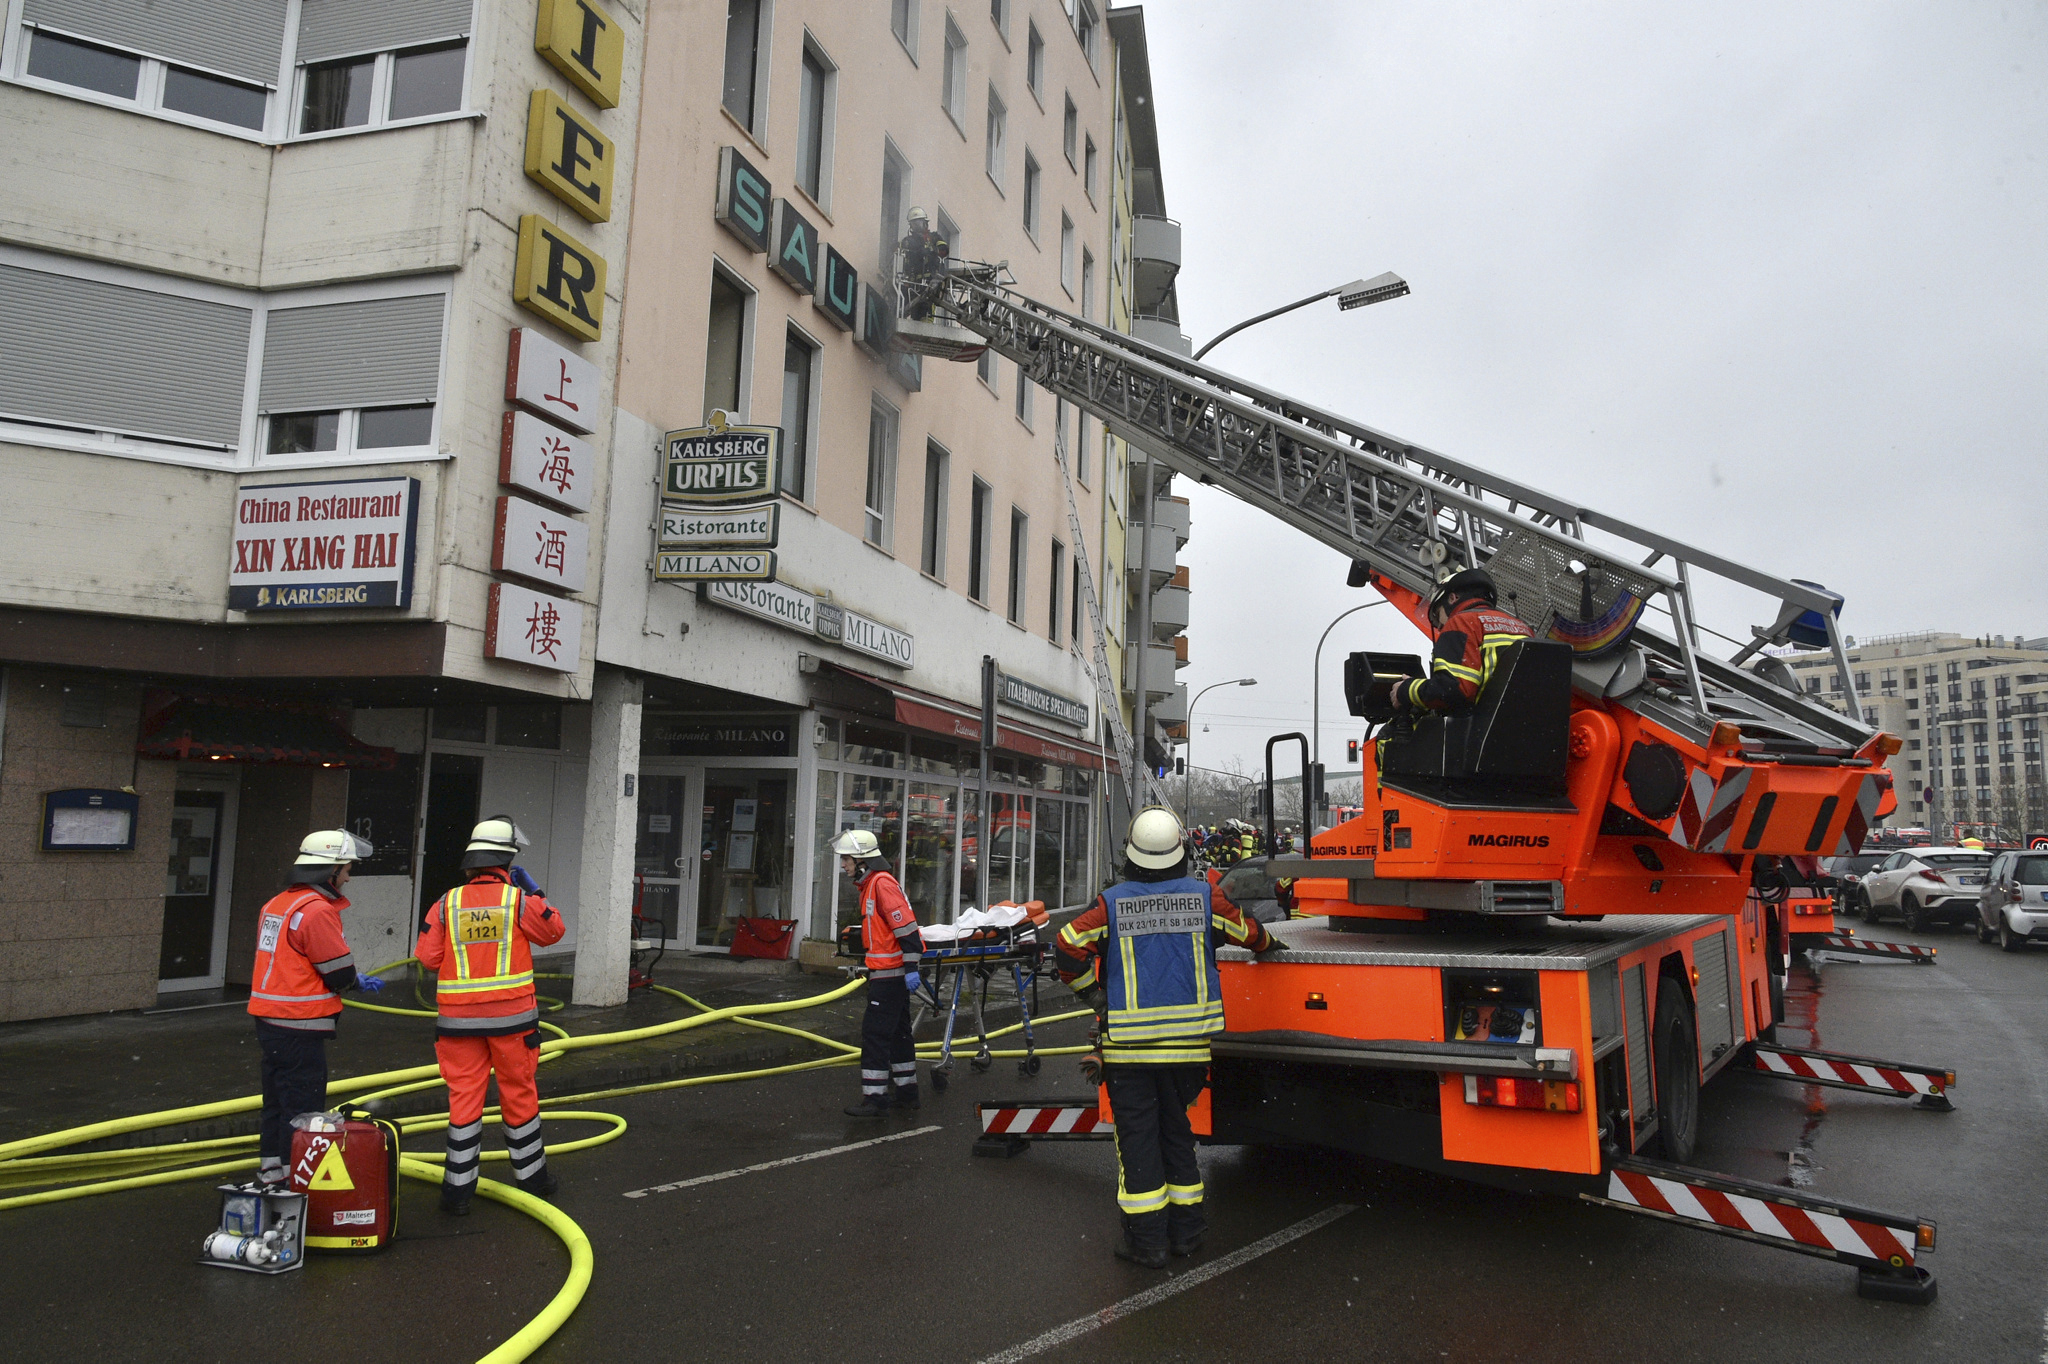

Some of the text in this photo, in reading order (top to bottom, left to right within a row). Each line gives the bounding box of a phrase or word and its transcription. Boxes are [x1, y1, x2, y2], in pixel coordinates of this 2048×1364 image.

[671, 437, 766, 459] KARLSBERG
[675, 462, 759, 489] URPILS
[239, 491, 402, 524] China Restaurant
[526, 358, 579, 662] 上海酒樓
[663, 518, 767, 535] Ristorante
[233, 532, 399, 573] XIN XANG HAI
[662, 556, 761, 573] MILANO
[275, 585, 368, 606] KARLSBERG
[819, 618, 840, 638] URPILS
[847, 615, 911, 661] MILANO
[1007, 681, 1050, 711] ITALIENISCHE
[1050, 697, 1088, 723] SPEZIALITÄTEN
[1695, 717, 1713, 733] 30m
[714, 730, 785, 742] MILANO
[355, 817, 373, 840] 13
[1468, 834, 1550, 847] MAGIRUS
[1118, 896, 1202, 914] TRUPPFÜHRER
[471, 910, 491, 922] NA
[1119, 922, 1134, 931] DLK
[1136, 919, 1157, 929] 23/12
[1170, 918, 1180, 927] SB
[1183, 917, 1204, 927] 18/31
[467, 926, 497, 938] 1121
[294, 1135, 330, 1187] 1753
[351, 1238, 368, 1246] PAX
